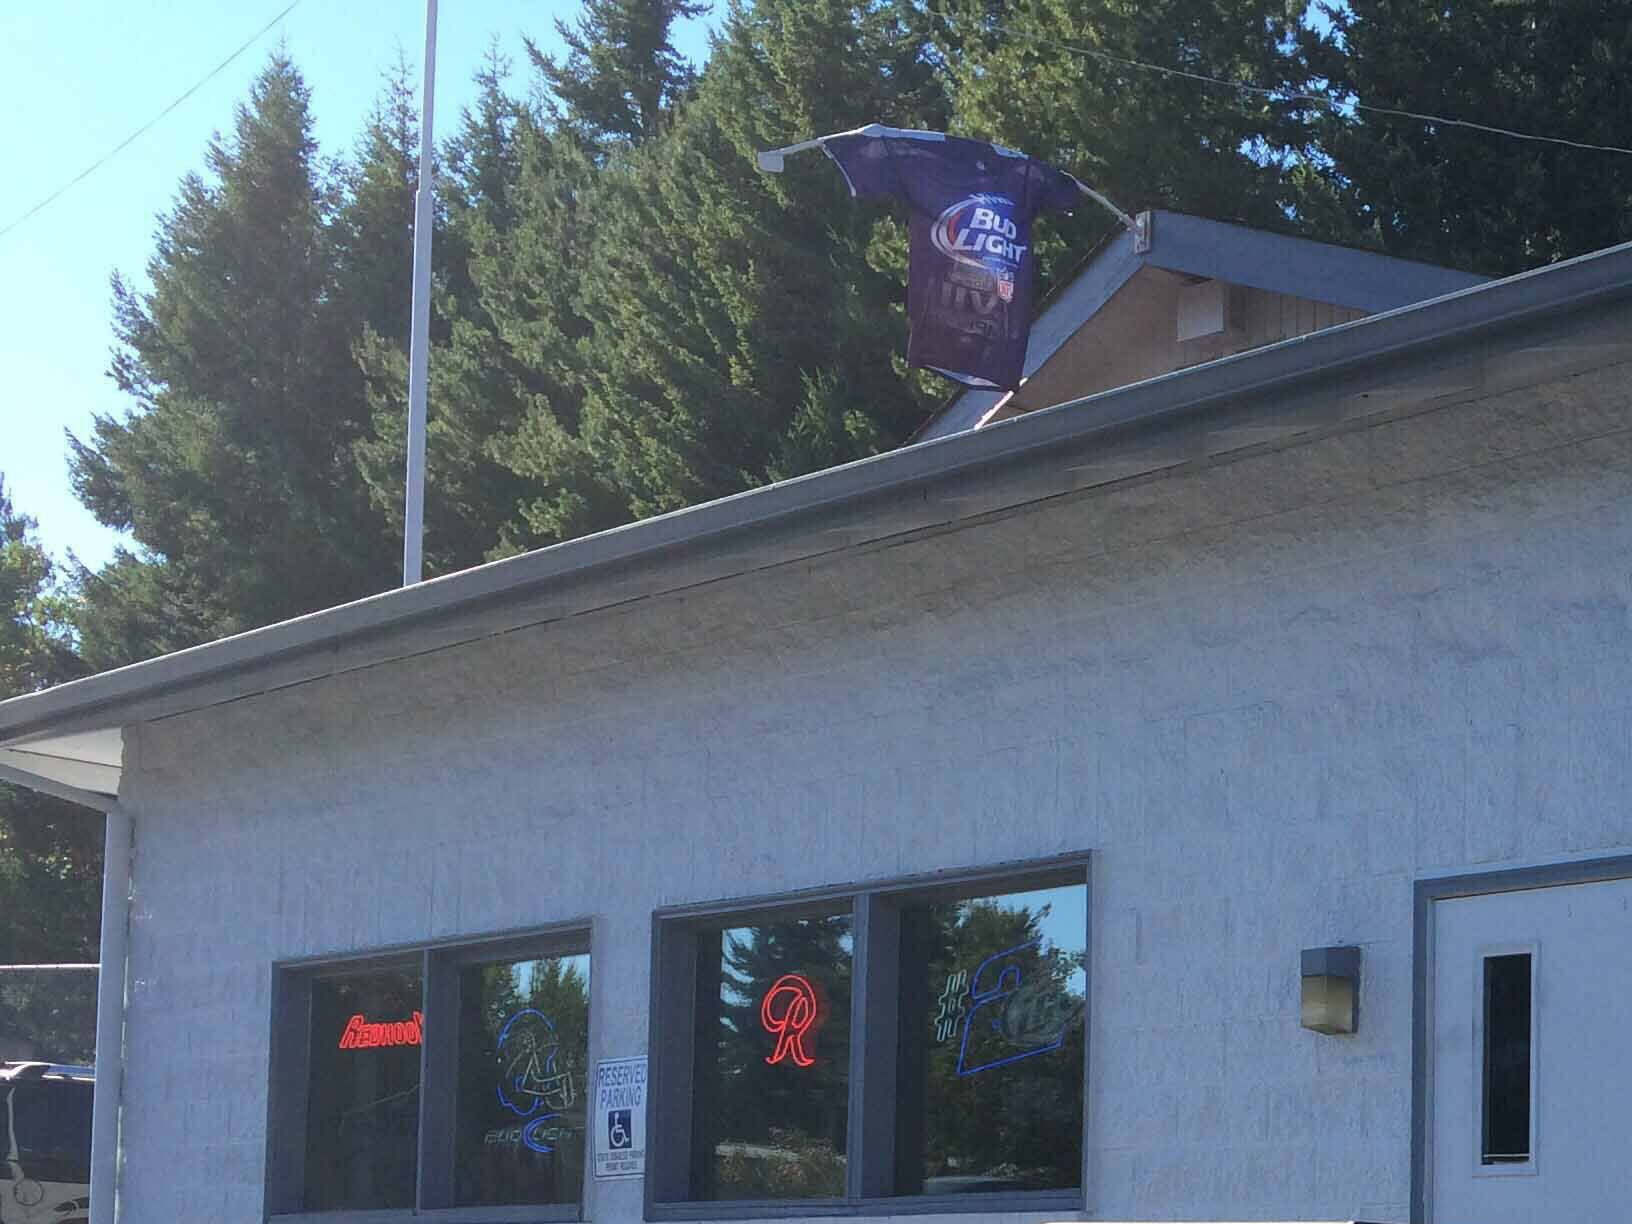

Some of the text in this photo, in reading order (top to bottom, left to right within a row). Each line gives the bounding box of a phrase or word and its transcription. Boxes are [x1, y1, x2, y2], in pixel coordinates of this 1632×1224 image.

[969, 207, 1017, 239] BUD
[952, 228, 1027, 262] LIGHT
[600, 1064, 646, 1087] RESERVED
[600, 1085, 641, 1109] PARKING
